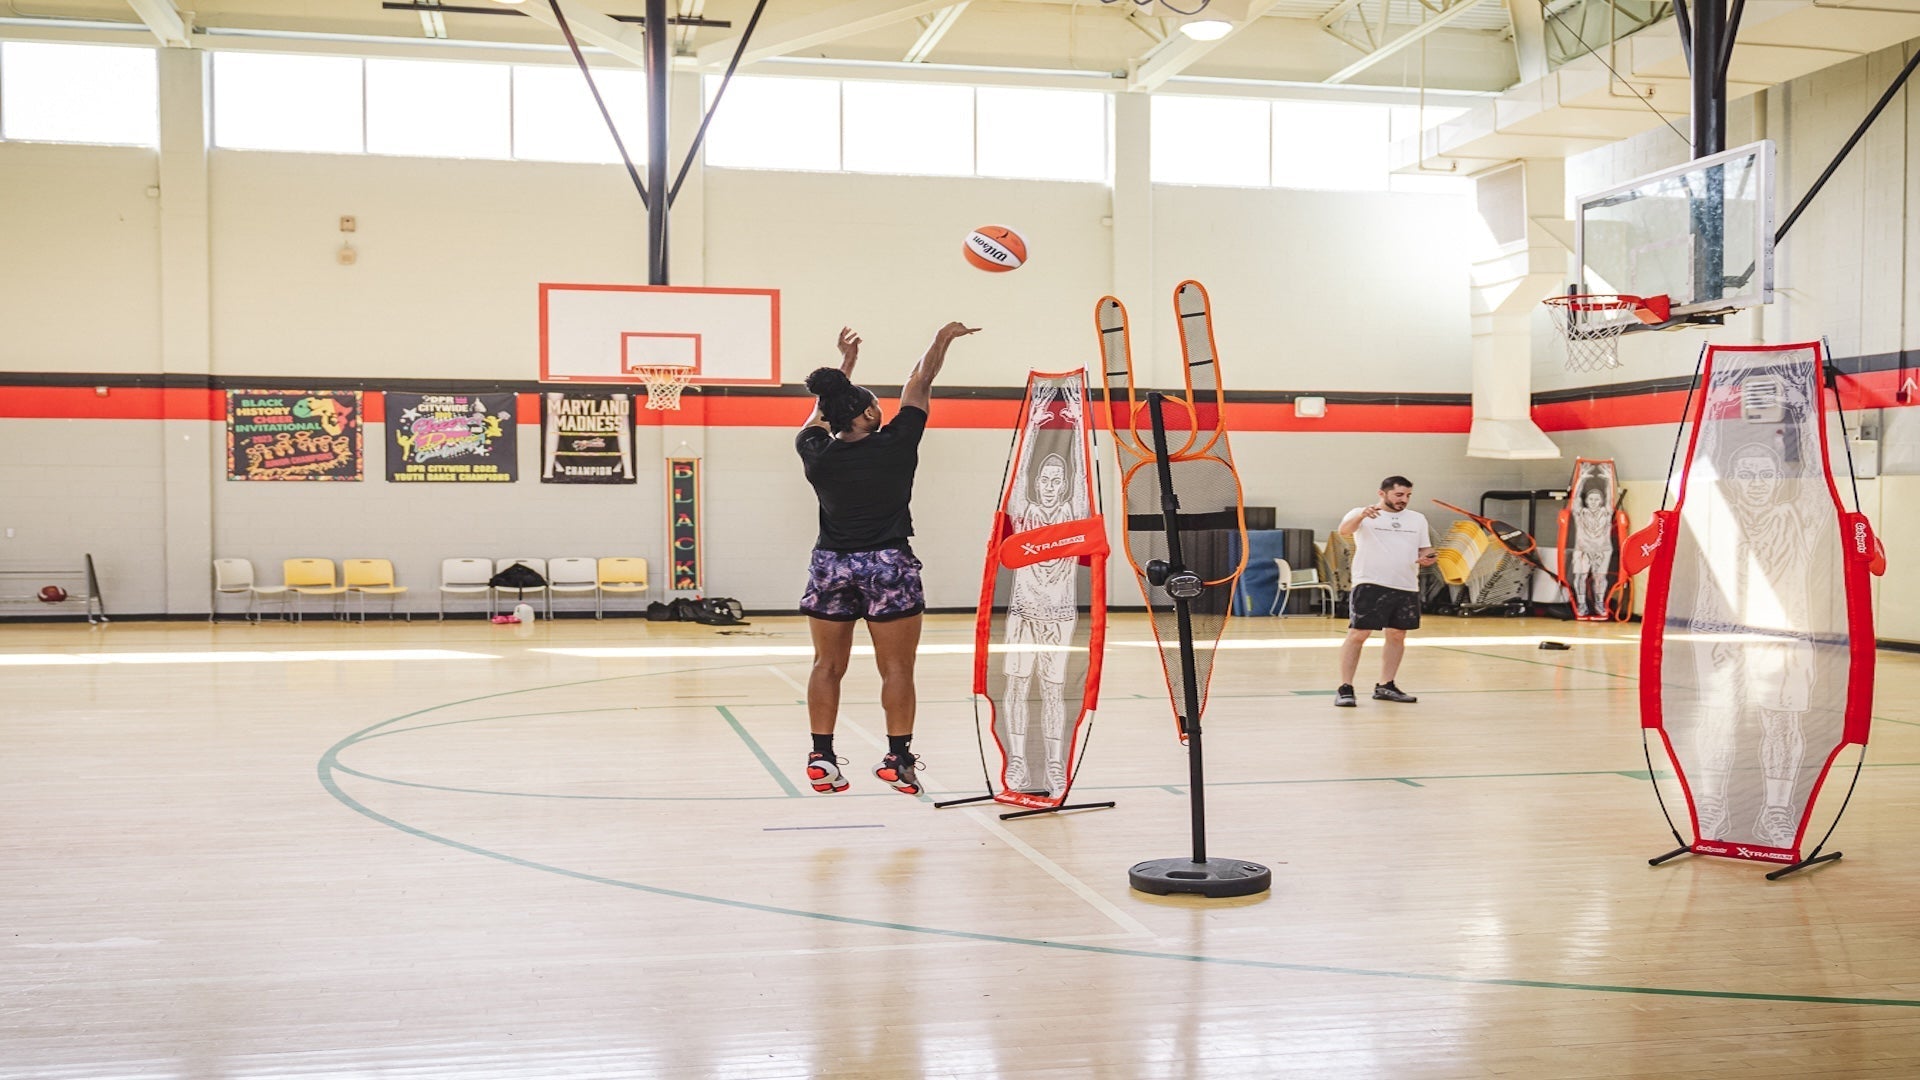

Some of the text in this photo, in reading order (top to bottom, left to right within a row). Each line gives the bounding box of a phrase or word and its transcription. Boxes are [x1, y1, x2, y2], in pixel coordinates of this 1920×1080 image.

[972, 235, 1008, 262] Wilson
[241, 399, 284, 407] BLACK
[429, 396, 455, 404] DPR
[235, 407, 291, 416] HISTORY
[417, 404, 469, 412] CITYWIDE
[547, 399, 630, 416] MARYLAND
[253, 416, 293, 424] CHEER
[553, 415, 623, 432] MADNESS
[235, 423, 322, 433] INVITATIONAL
[427, 464, 471, 473] CITYWIDE
[565, 466, 613, 476] CHAMPION
[394, 472, 425, 482] YOUTH
[458, 472, 511, 482] CHAMPIONS
[673, 464, 695, 575] BLACK
